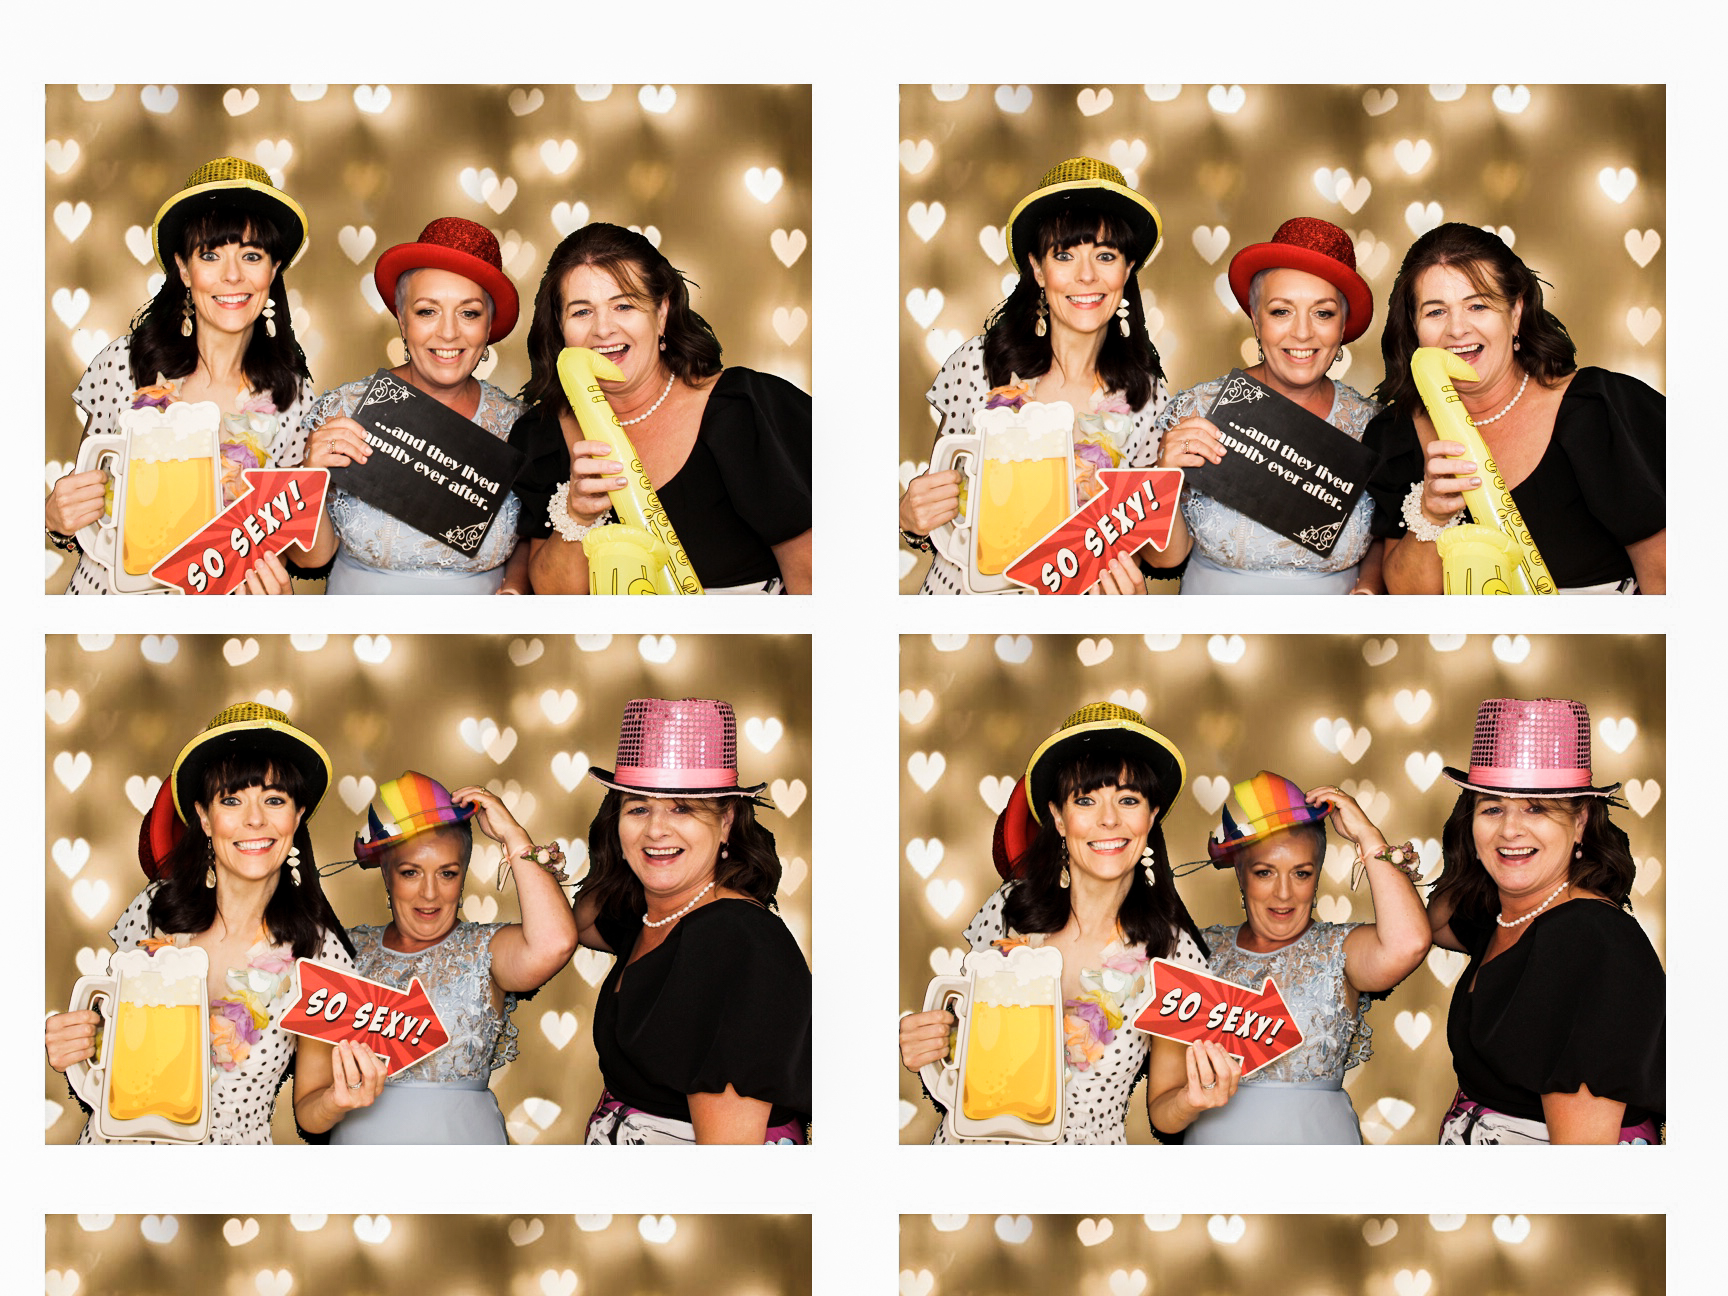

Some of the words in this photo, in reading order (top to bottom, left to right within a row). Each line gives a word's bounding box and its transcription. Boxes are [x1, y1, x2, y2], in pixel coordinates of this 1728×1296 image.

[364, 431, 414, 464] appily
[414, 461, 449, 485] ever
[448, 481, 488, 511] after.
[375, 422, 426, 451] ...and
[426, 445, 462, 470] they
[461, 465, 500, 495] lived
[1218, 431, 1268, 464] appily
[1268, 461, 1303, 485] ever
[1302, 481, 1342, 511] after.
[1229, 422, 1280, 451] ...and
[1280, 445, 1316, 470] they
[1315, 465, 1354, 495] lived
[187, 547, 225, 593] SO
[230, 479, 306, 558] SEXY!
[1041, 547, 1079, 593] SO
[1084, 479, 1160, 558] SEXY!
[305, 987, 348, 1022] SO
[352, 1002, 431, 1046] SEXY!
[1159, 987, 1202, 1022] SO
[1206, 1002, 1285, 1046] SEXY!
